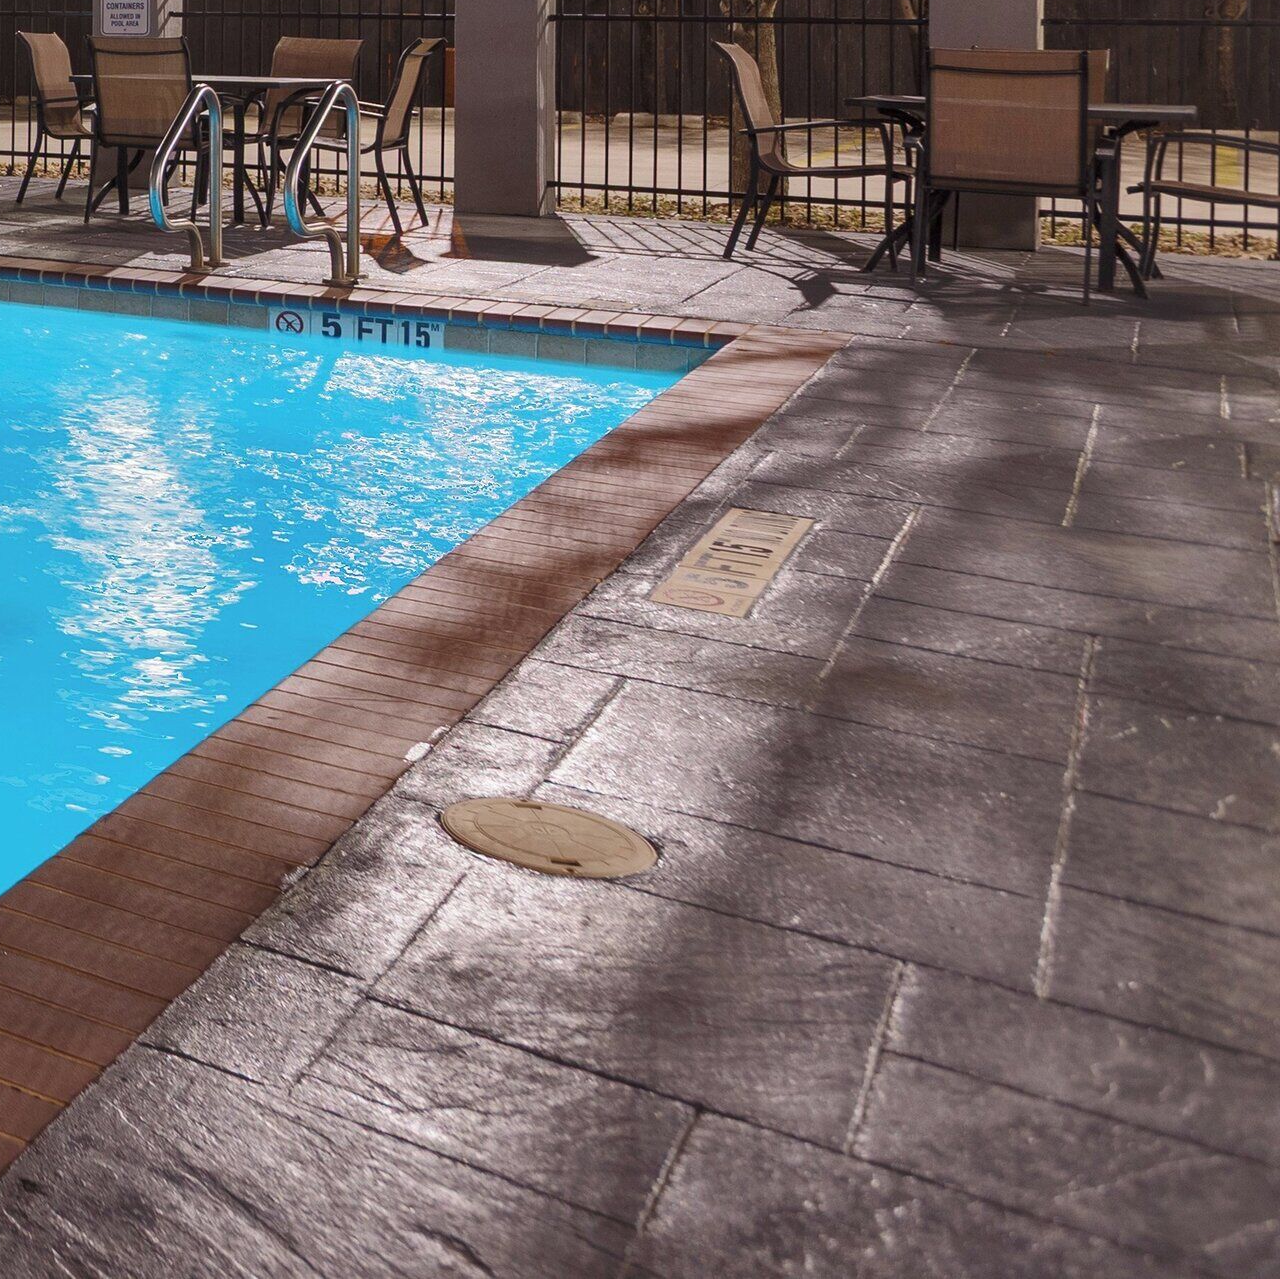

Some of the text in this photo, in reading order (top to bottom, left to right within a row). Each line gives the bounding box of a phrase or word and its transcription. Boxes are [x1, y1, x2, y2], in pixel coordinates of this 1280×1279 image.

[106, 2, 145, 10] CONTAINERS
[321, 312, 342, 338] 5
[357, 316, 394, 344] FT
